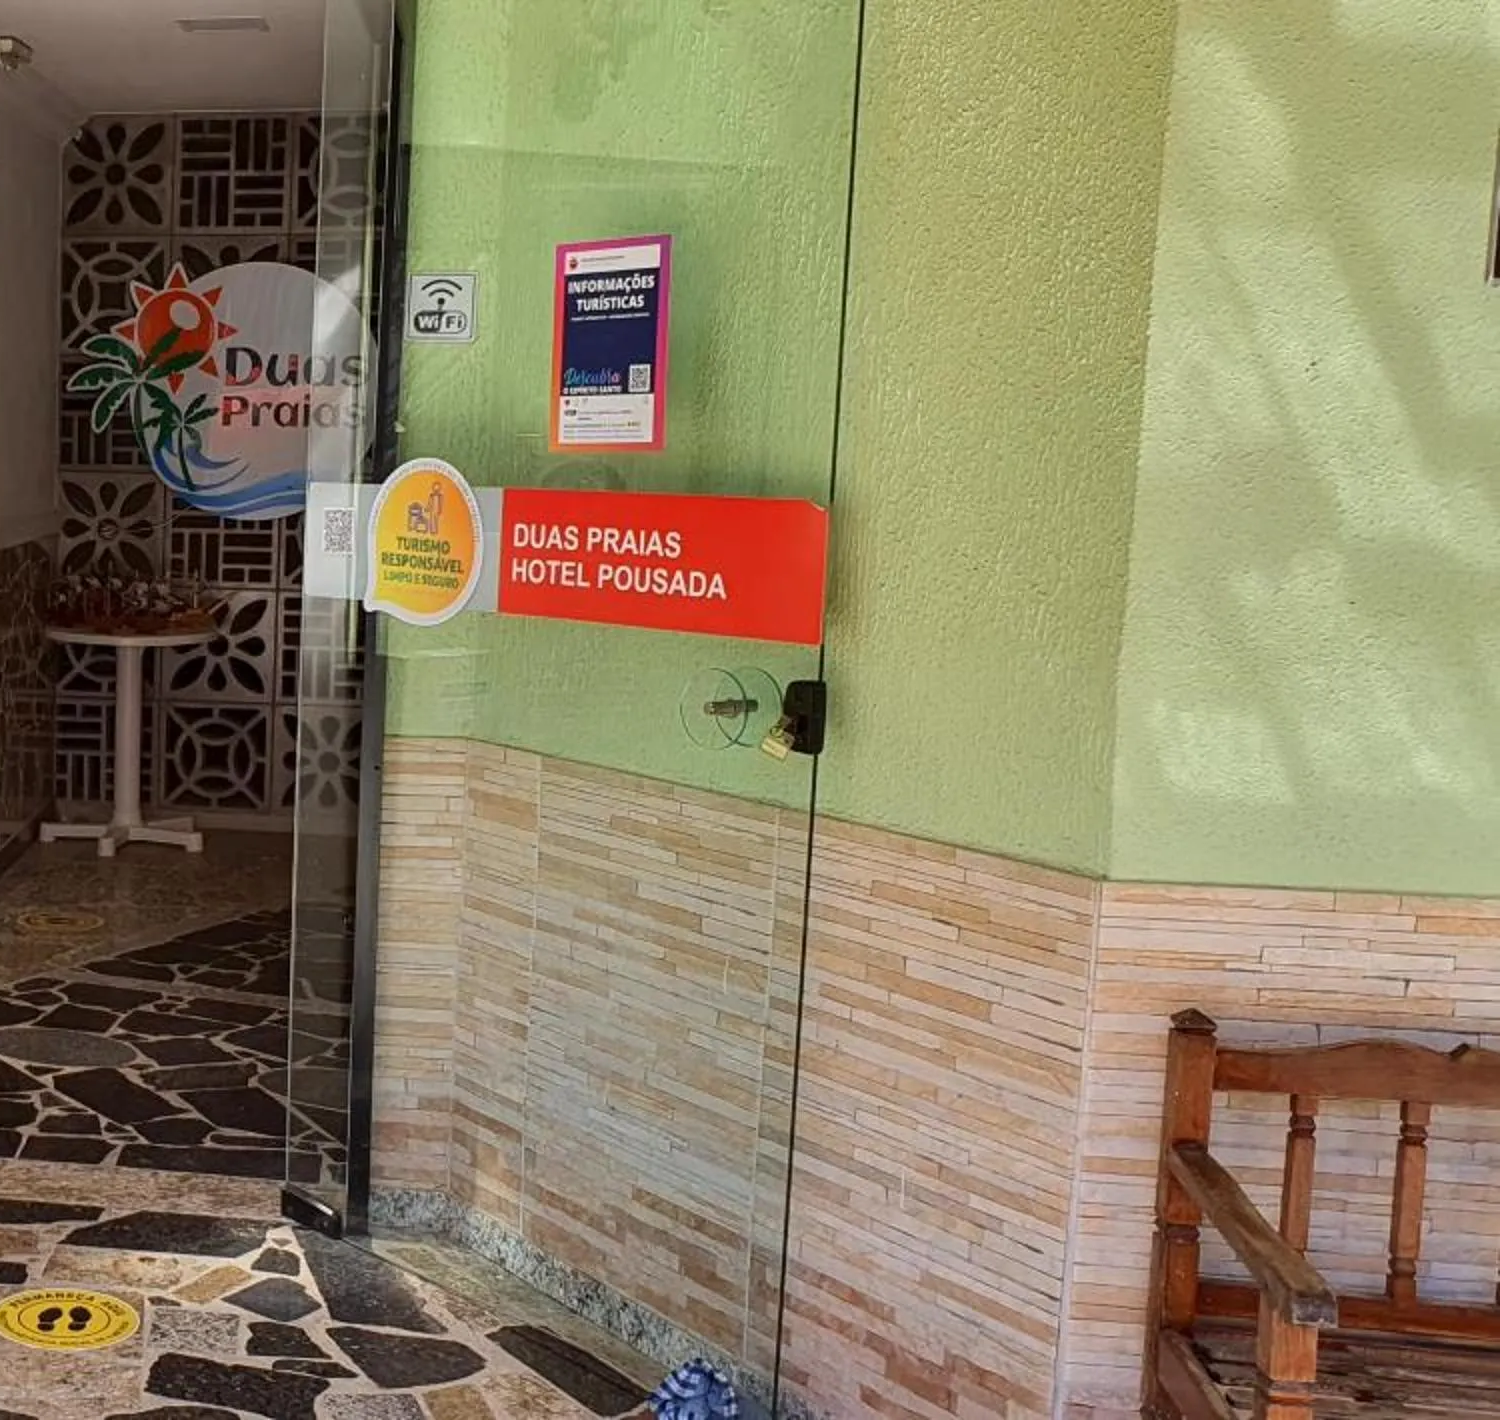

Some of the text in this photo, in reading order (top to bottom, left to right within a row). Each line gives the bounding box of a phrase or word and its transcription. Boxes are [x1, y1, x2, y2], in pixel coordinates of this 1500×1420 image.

[568, 273, 655, 294] INFORMAÇÕES
[576, 294, 645, 312] TURÍSTICAS
[225, 347, 362, 387] Duas
[221, 393, 365, 428] Praias
[396, 536, 451, 554] TURISMO
[512, 523, 682, 559] DUAS PRAIAS
[382, 551, 465, 573] RESPONSÁVEL
[414, 573, 421, 584] E
[511, 558, 728, 600] HOTEL POUSADA
